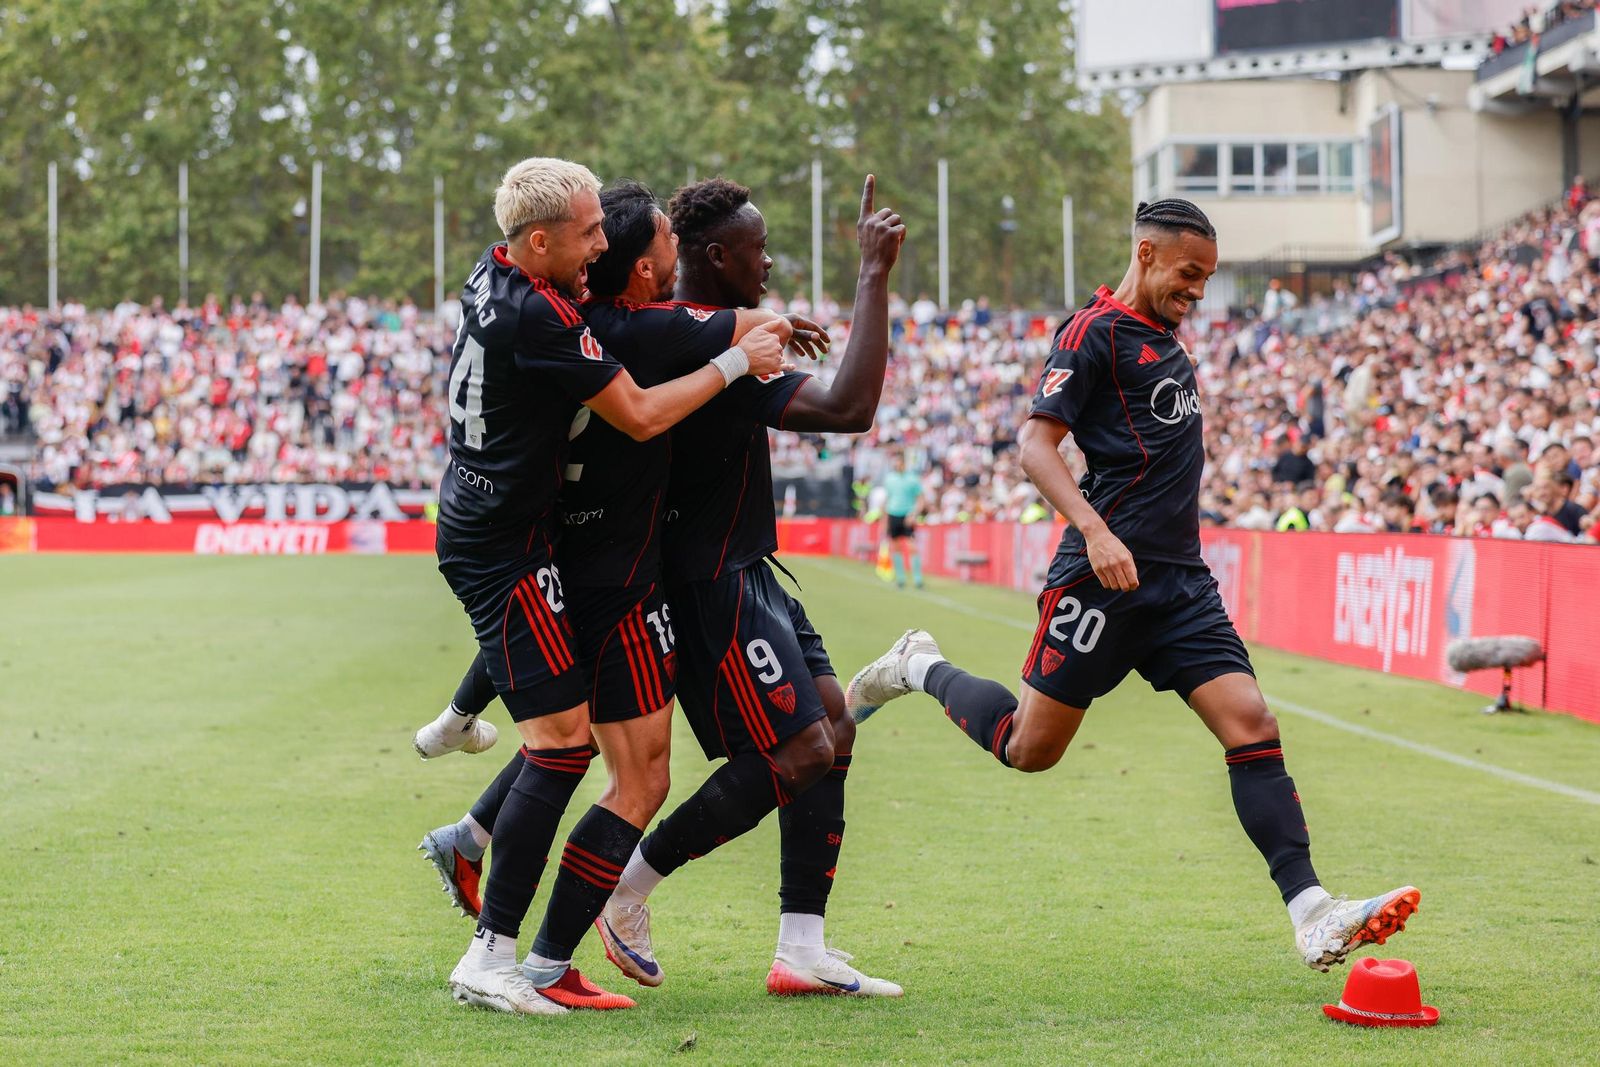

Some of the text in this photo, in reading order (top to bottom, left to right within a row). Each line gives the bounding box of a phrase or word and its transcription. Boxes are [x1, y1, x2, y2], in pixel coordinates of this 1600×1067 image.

[448, 303, 486, 450] 4
[201, 484, 407, 524] VIDA
[1048, 595, 1106, 654] 20
[746, 638, 783, 684] 9
